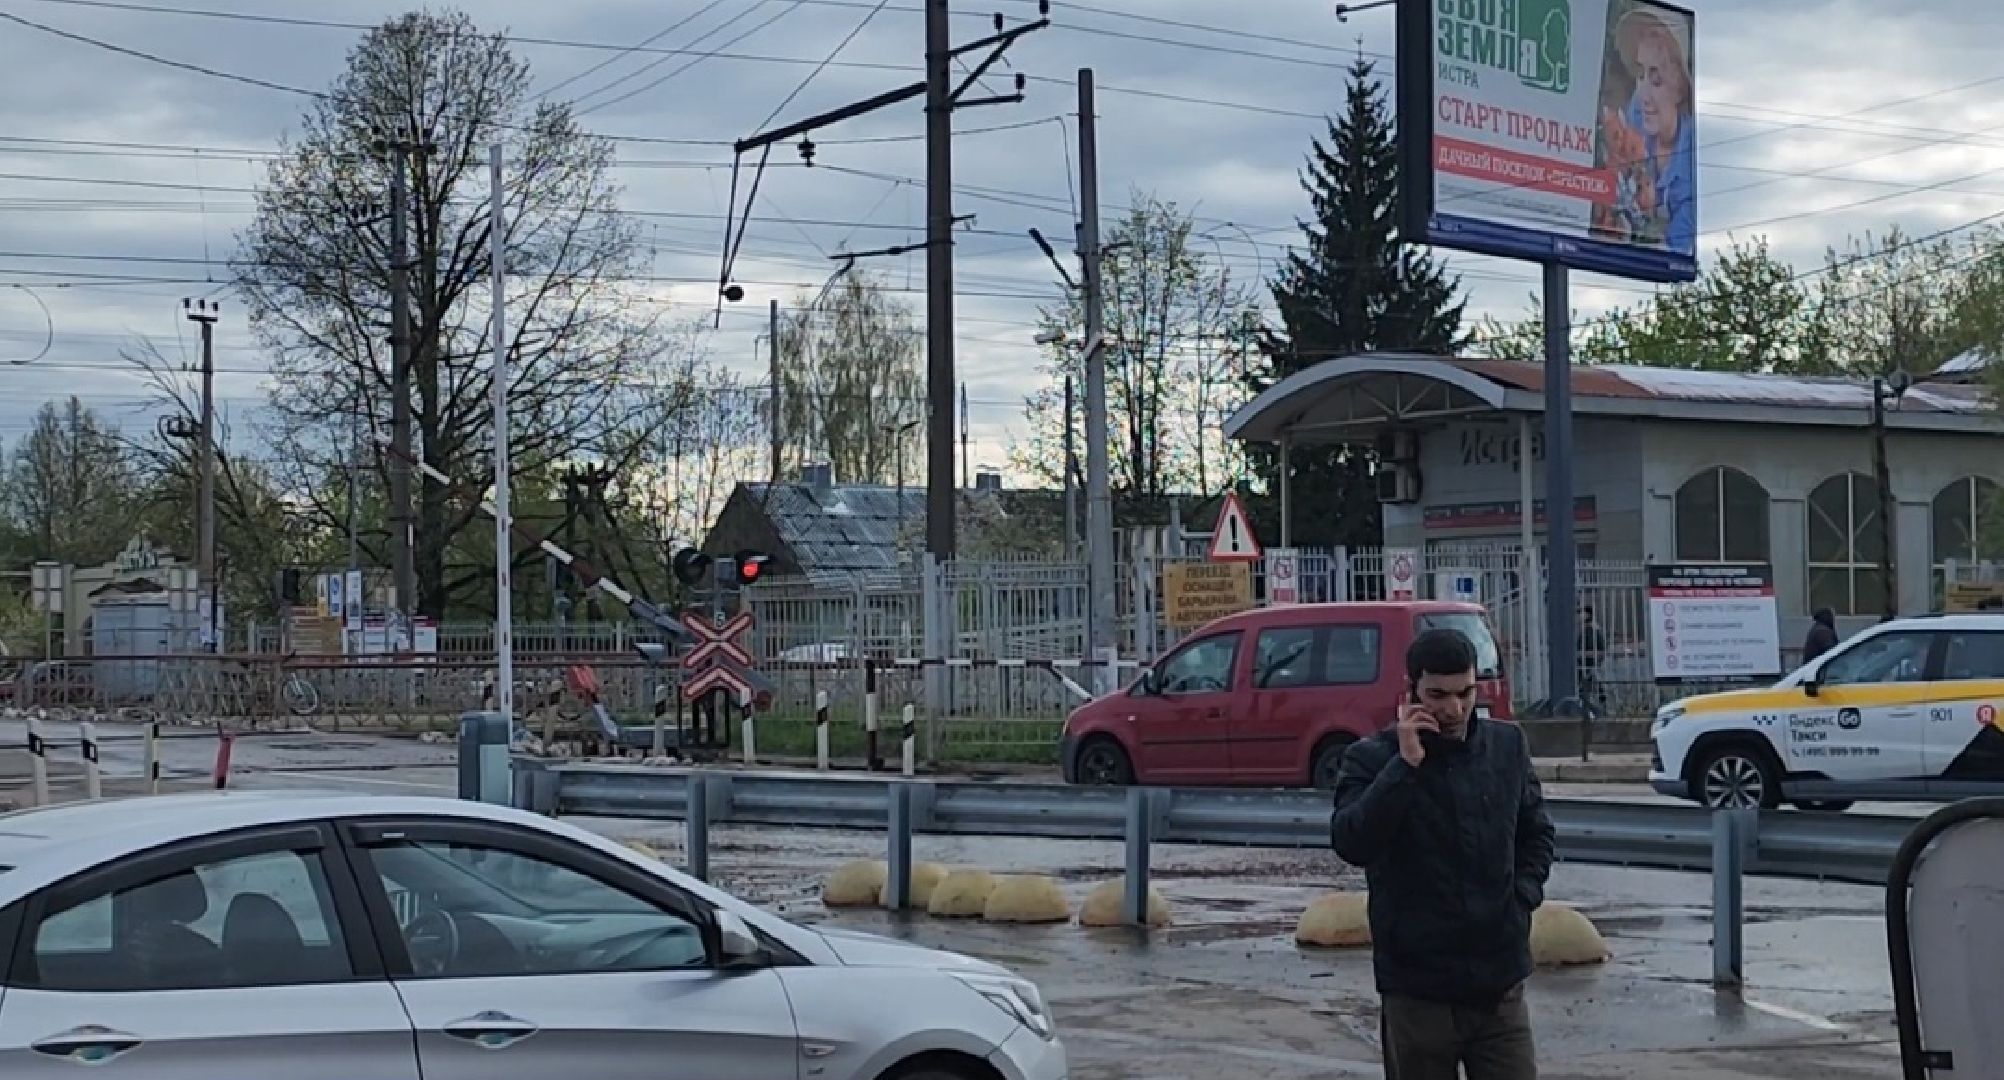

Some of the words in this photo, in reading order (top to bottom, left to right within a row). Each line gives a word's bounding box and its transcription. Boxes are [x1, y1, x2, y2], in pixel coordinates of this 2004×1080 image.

[1438, 18, 1537, 77] ЗЕМЛЯ
[1438, 62, 1479, 89] ИСТРА
[1439, 95, 1501, 133] СТАРТ
[1507, 110, 1592, 155] ПРОДАЖ
[1438, 147, 1490, 171] ДАЧНЫЙ
[1790, 713, 1834, 728] Яндекс
[1840, 710, 1859, 727] Go
[1930, 708, 1953, 721] 901
[1791, 730, 1827, 742] Такси
